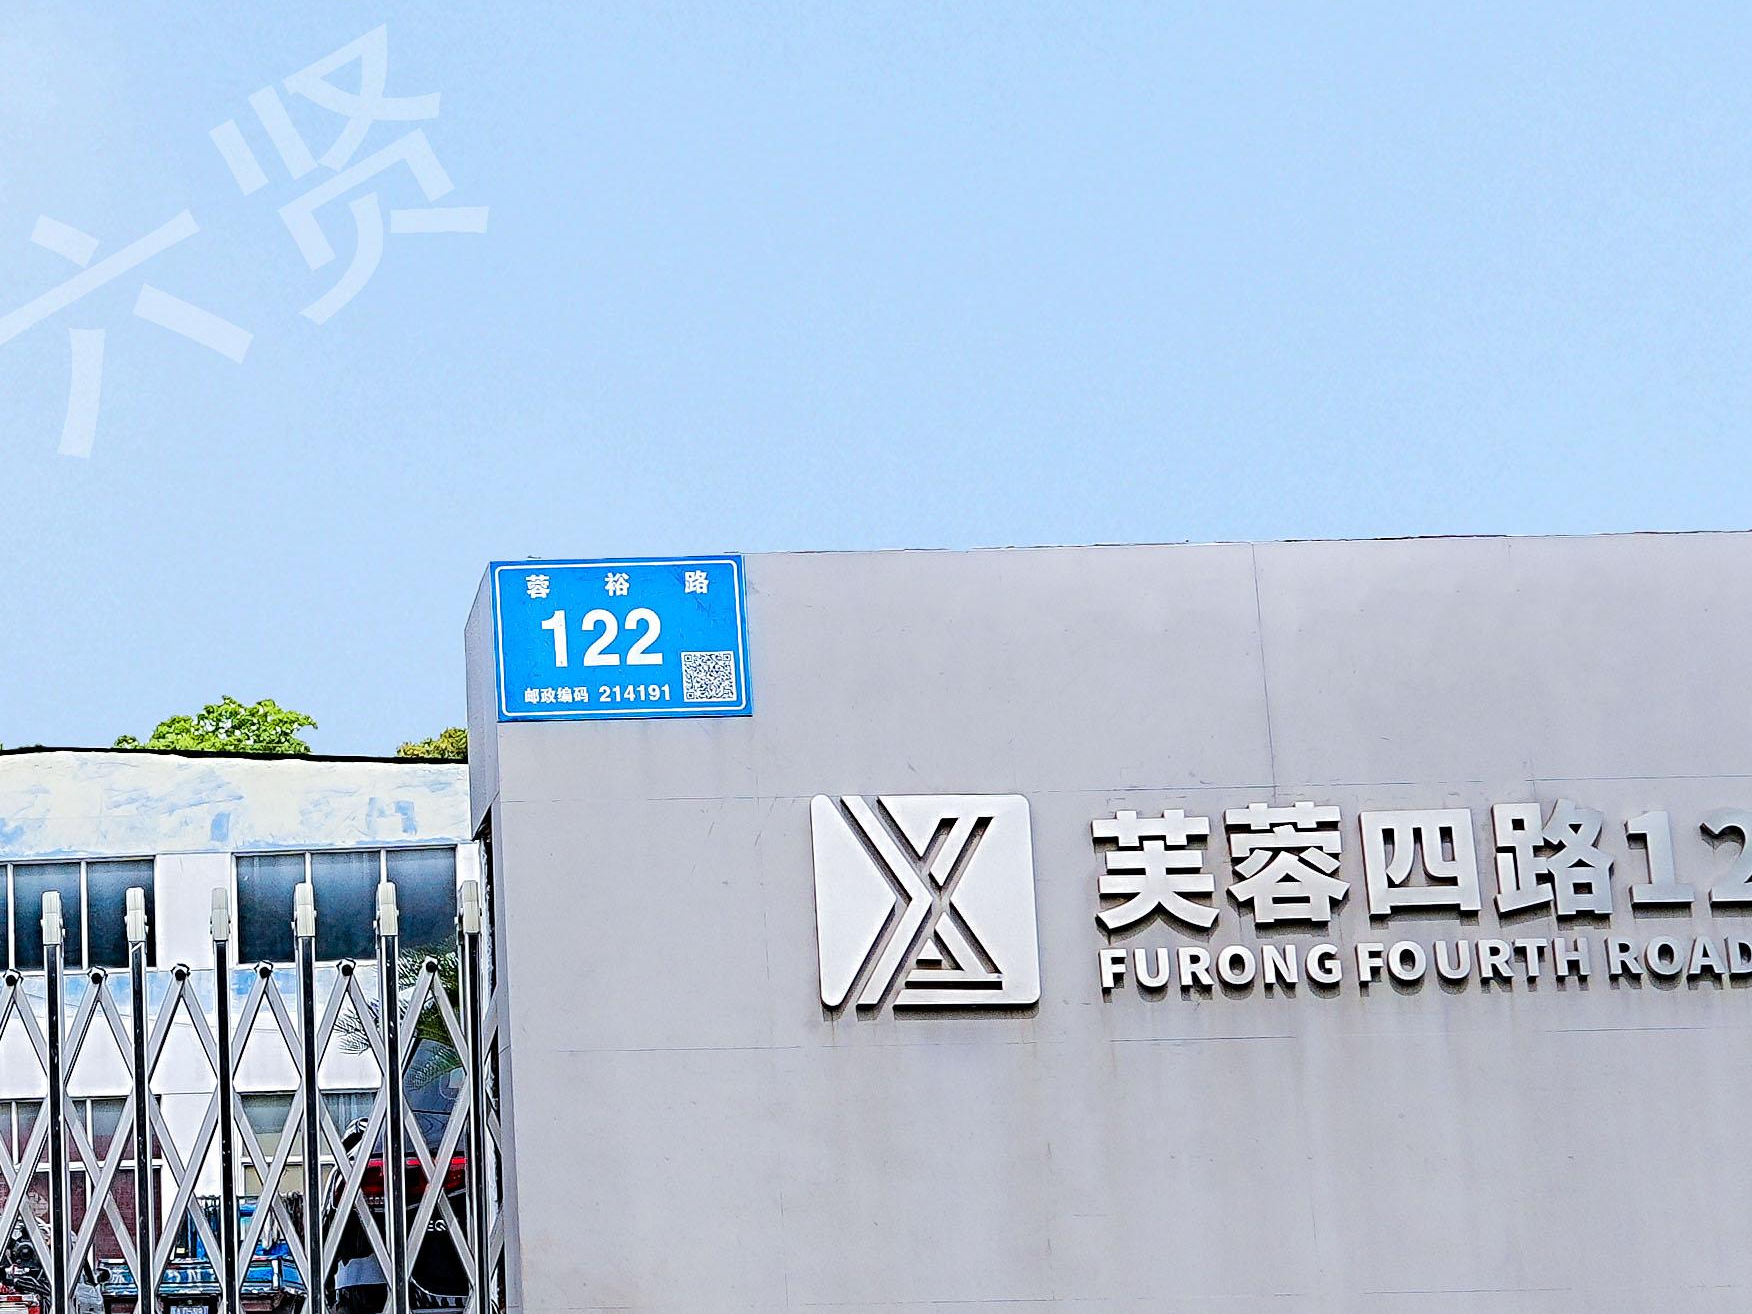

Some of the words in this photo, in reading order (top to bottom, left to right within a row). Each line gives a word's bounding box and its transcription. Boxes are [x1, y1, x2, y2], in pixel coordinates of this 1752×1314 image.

[541, 607, 663, 667] 122
[524, 687, 589, 704] 邮政编码
[599, 684, 671, 702] 214191
[1098, 943, 1343, 989] FURONG
[1356, 937, 1592, 984] FOURTH
